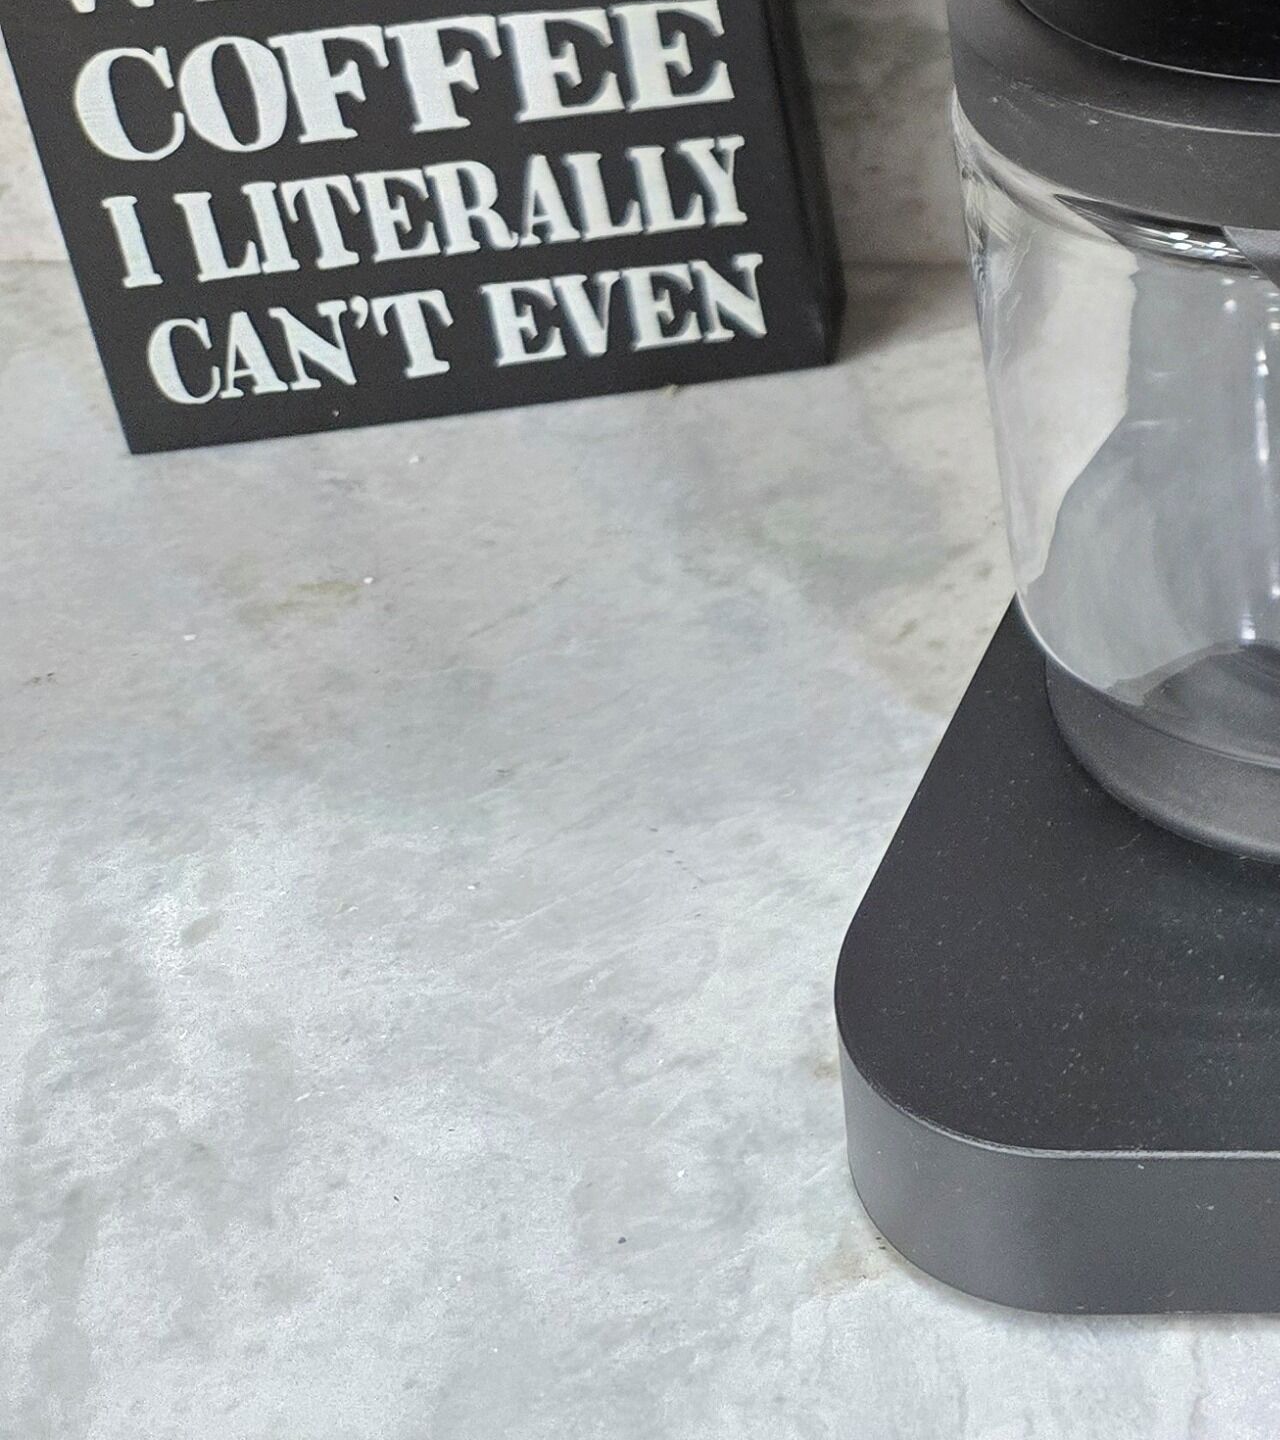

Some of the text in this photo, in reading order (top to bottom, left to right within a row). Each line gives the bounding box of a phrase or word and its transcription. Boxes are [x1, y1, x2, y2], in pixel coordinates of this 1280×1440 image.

[101, 135, 747, 289] I LITERALLY
[480, 253, 767, 368] EVEN
